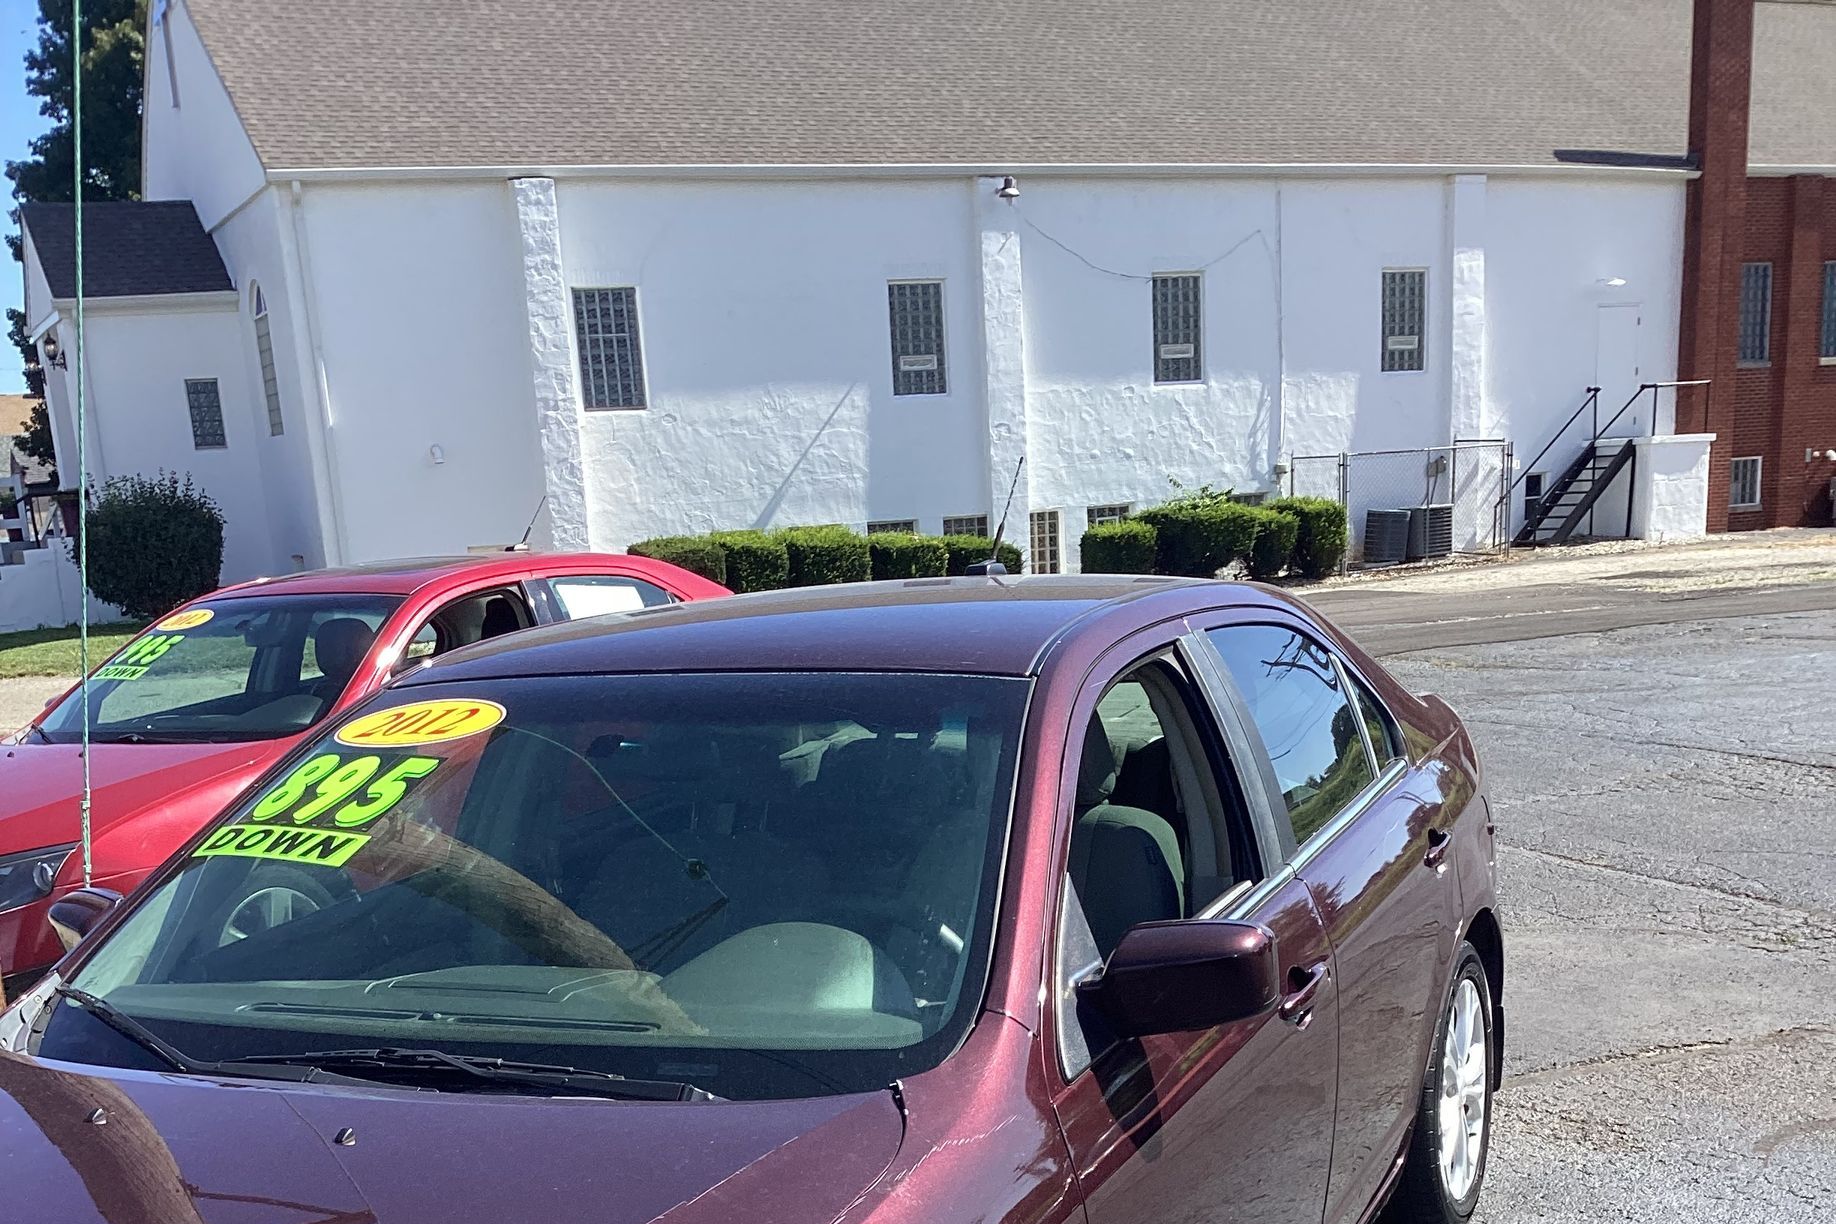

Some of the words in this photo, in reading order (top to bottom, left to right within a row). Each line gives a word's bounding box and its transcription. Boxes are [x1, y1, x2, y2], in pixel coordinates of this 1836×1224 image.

[95, 667, 142, 679] DOWN
[353, 707, 481, 739] 2012
[252, 754, 441, 827] 895
[202, 827, 351, 860] DOWN
